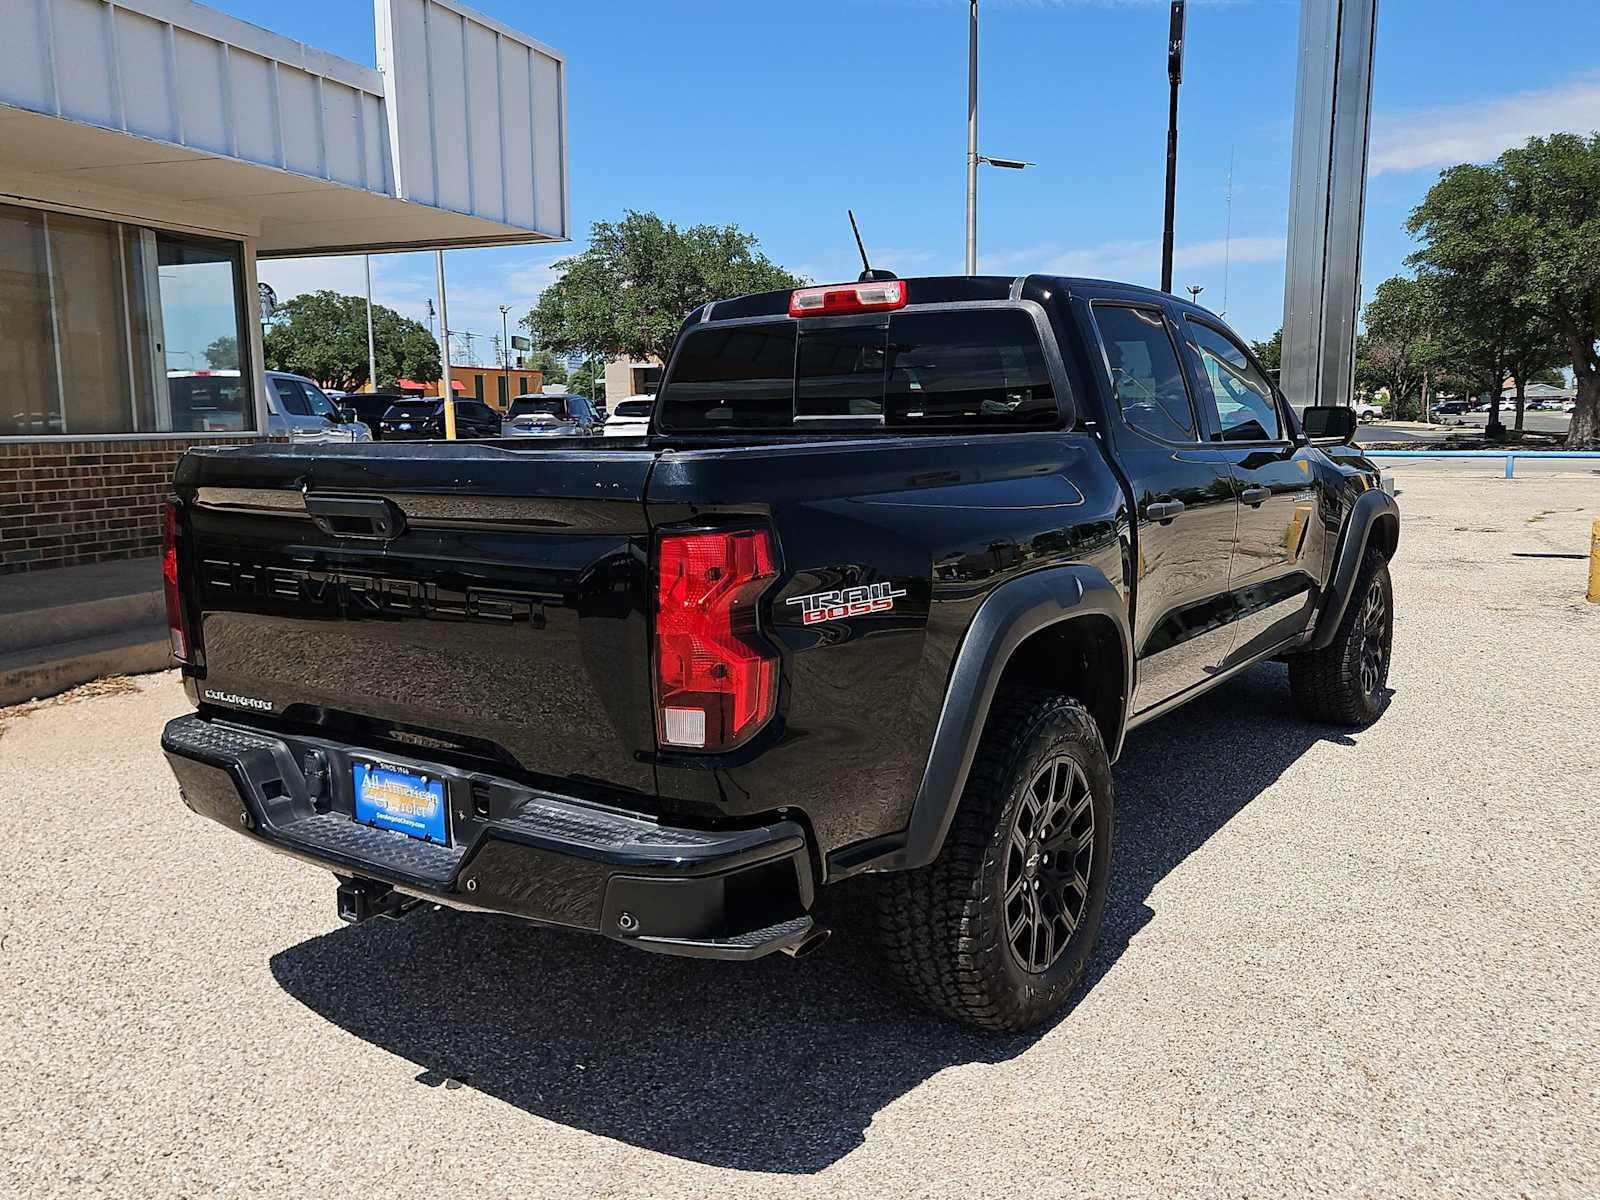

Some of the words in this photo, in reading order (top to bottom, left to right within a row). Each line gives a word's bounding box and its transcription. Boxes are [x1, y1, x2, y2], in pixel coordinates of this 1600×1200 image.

[203, 558, 564, 629] CHEVROLET
[786, 582, 907, 612] TRAIL
[802, 598, 893, 625] BOSS
[204, 689, 273, 711] COLORADO
[362, 773, 379, 789] All
[383, 778, 438, 803] American
